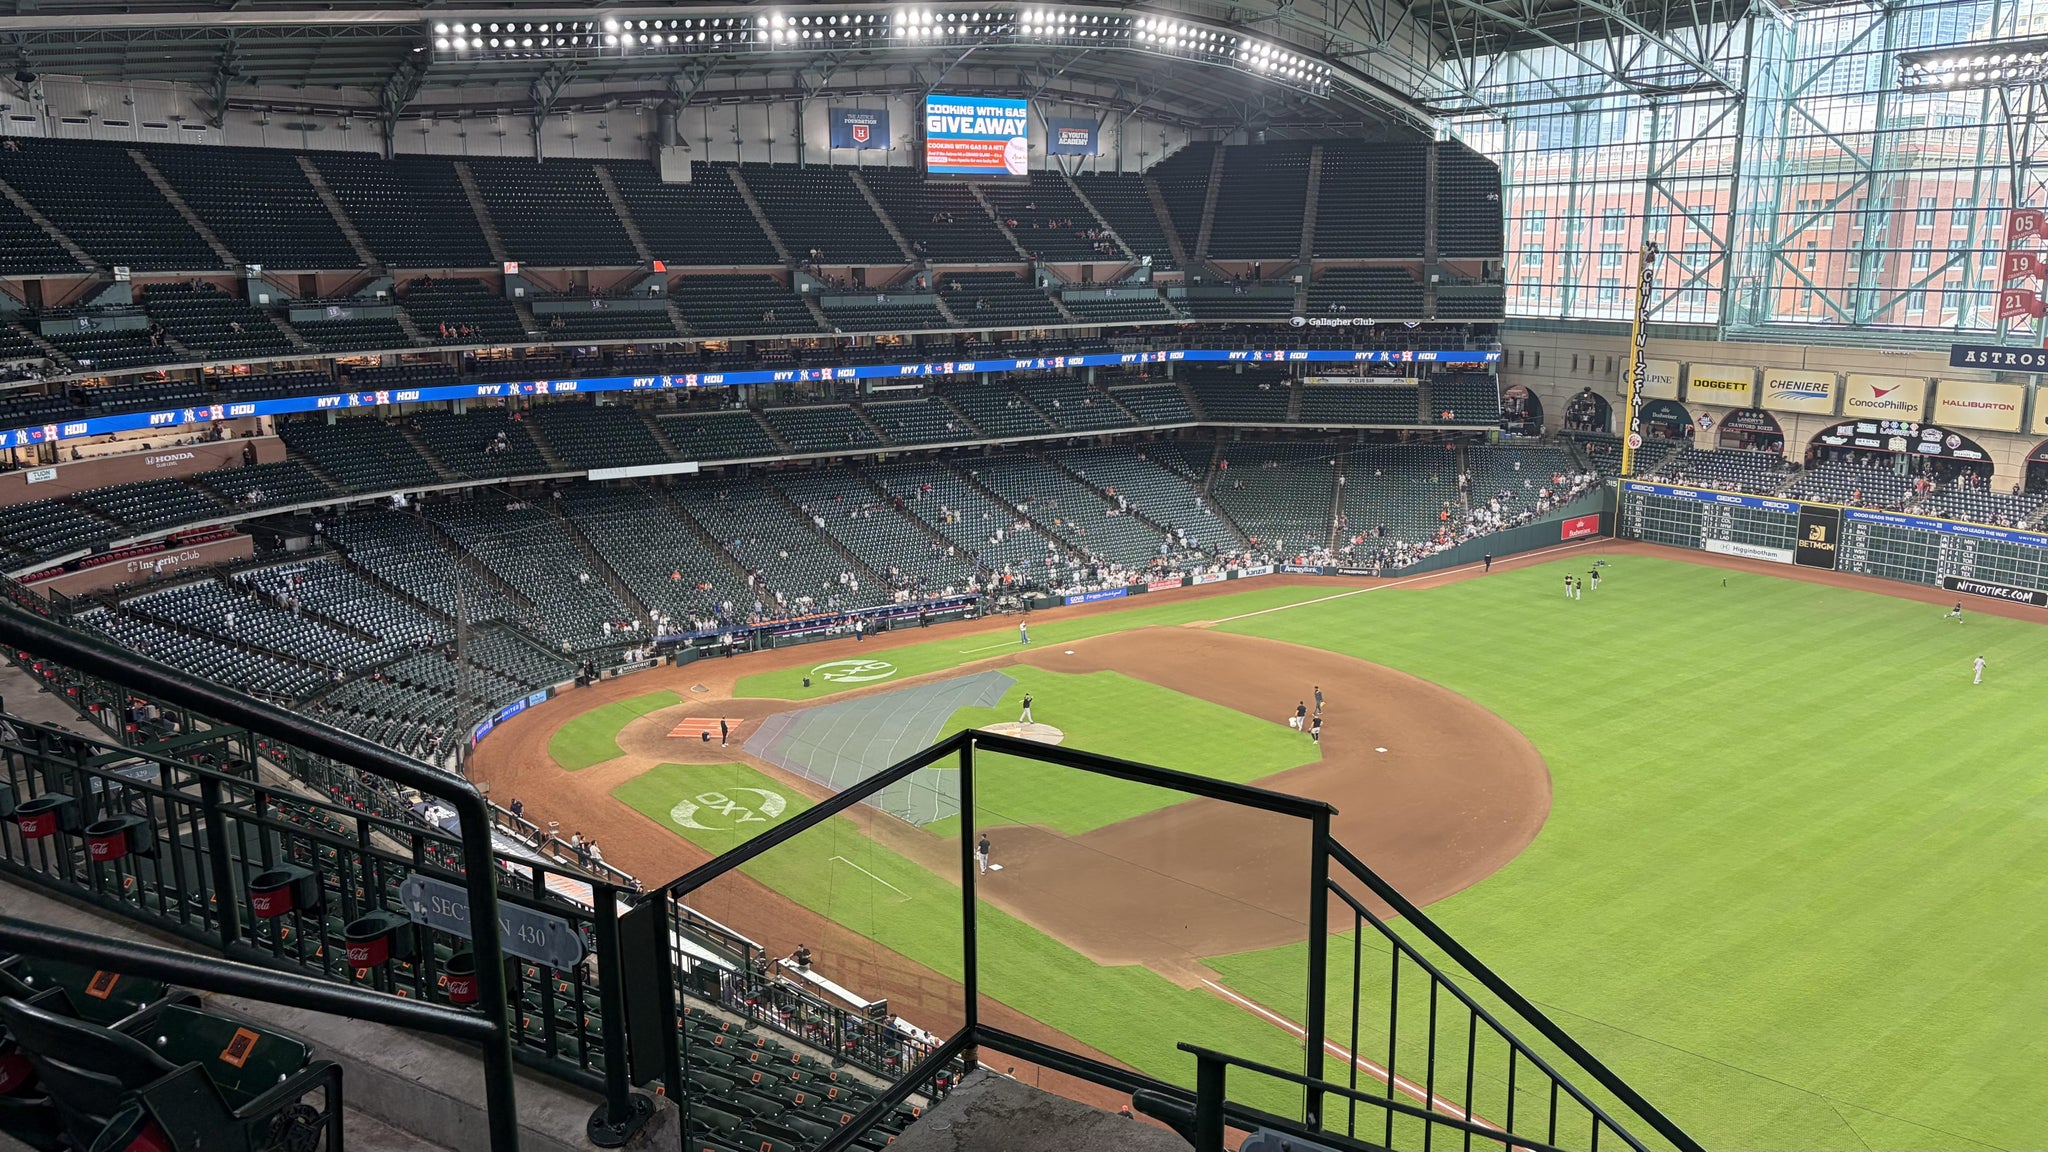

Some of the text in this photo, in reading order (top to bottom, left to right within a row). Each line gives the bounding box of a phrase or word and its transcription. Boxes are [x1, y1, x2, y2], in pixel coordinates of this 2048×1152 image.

[927, 104, 1026, 117] COOKING WITH GAS
[927, 116, 1026, 135] GIVEAWAY
[2015, 216, 2033, 231] 05
[2012, 257, 2028, 271] 19
[2006, 295, 2021, 308] 21
[1308, 317, 1375, 327] Gallagher Club
[1121, 354, 1136, 362] NYY
[1229, 351, 1247, 359] NYY
[1355, 352, 1374, 360] NYY
[1418, 352, 1437, 360] HOU
[1965, 351, 2046, 366] ASTROS
[901, 363, 975, 374] NYY HOU
[1016, 357, 1084, 368] NYY HOU
[633, 378, 655, 388] NYY
[703, 374, 724, 384] HOU
[774, 371, 794, 381] NYY
[837, 369, 856, 378] HOU
[477, 385, 501, 395] NYY
[555, 381, 577, 391] HOU
[1694, 379, 1748, 391] DOGGETT
[1770, 379, 1829, 393] CHENIERE
[317, 397, 340, 408] NYY
[396, 390, 419, 401] HOU
[1631, 378, 1644, 432] FAIR
[1848, 398, 1918, 412] ConocoPhillips
[1942, 400, 2015, 411] HALLIBURTON
[150, 412, 175, 425] NYY
[230, 404, 255, 416] HOU
[1652, 412, 1678, 420] Budweiser
[64, 422, 88, 436] HOU
[155, 452, 195, 463] HONDA
[1632, 484, 1654, 492] GEICO
[1673, 489, 1698, 497] GEICO
[1716, 495, 1742, 503] GEICO
[1762, 501, 1789, 509] GEICO
[1569, 528, 1591, 537] Budweiser
[1701, 505, 1709, 548] NATIONAL
[1733, 546, 1778, 557] Higginbotham
[1799, 539, 1834, 551] BETMGM
[139, 550, 200, 570] Inserity Club
[1937, 537, 1947, 585] AMERICAN
[1957, 581, 2033, 604] NITTOTIRE.COM
[823, 661, 892, 680] OXY
[696, 792, 766, 823] OXY
[432, 896, 545, 947] SECN 430
